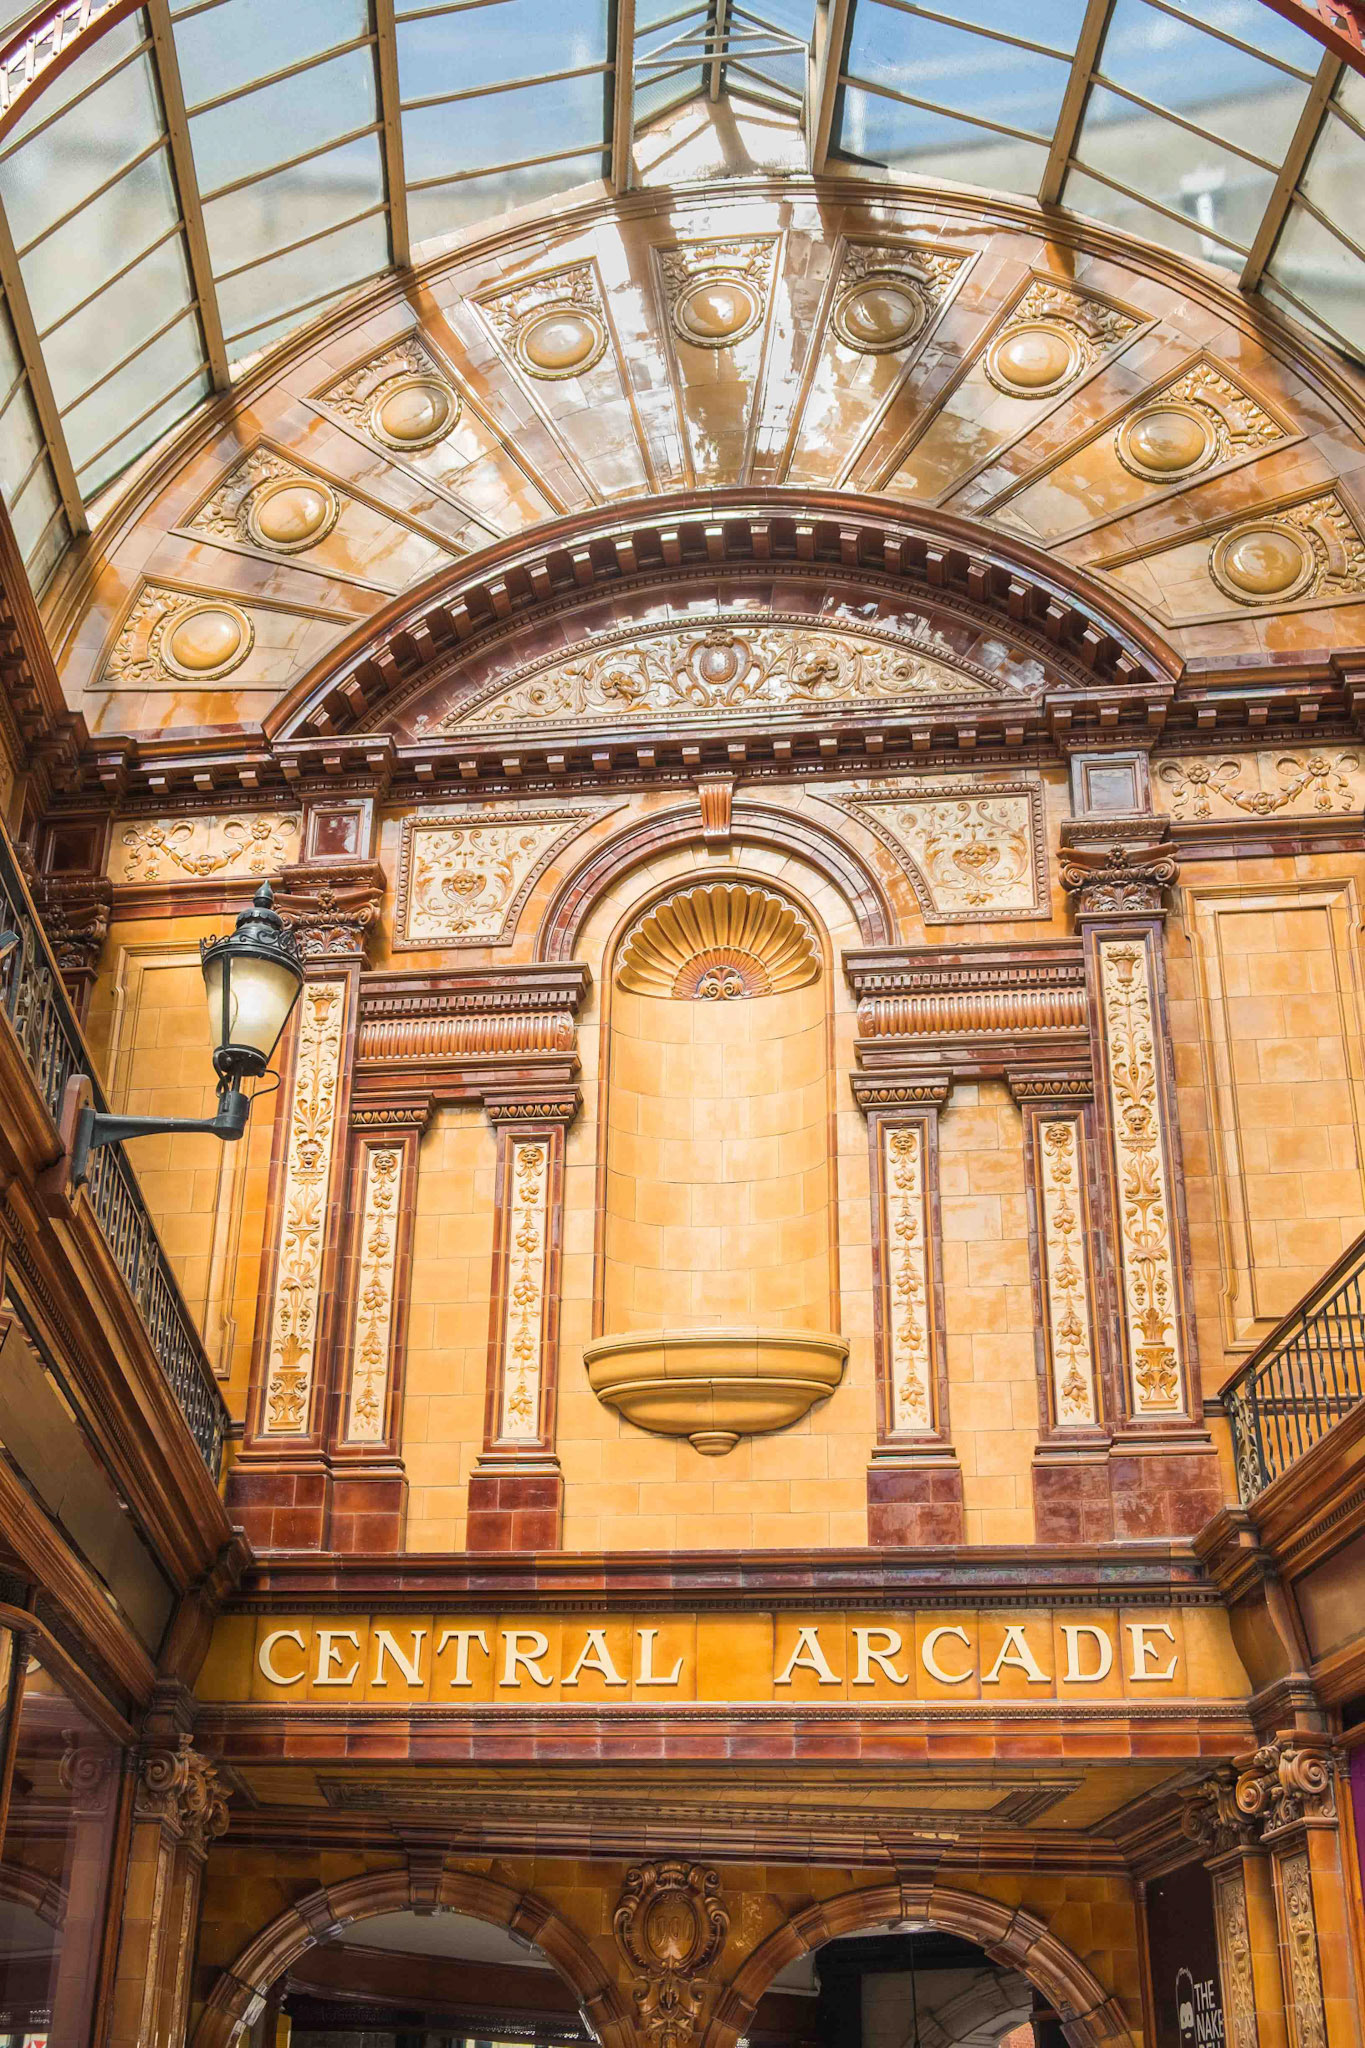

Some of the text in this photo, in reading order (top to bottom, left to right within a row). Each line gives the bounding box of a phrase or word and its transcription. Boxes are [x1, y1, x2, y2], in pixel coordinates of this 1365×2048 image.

[258, 1623, 1179, 1687] CENTRAL ARCADE
[1194, 1980, 1215, 2011] THE
[1196, 2009, 1224, 2042] NAKE
